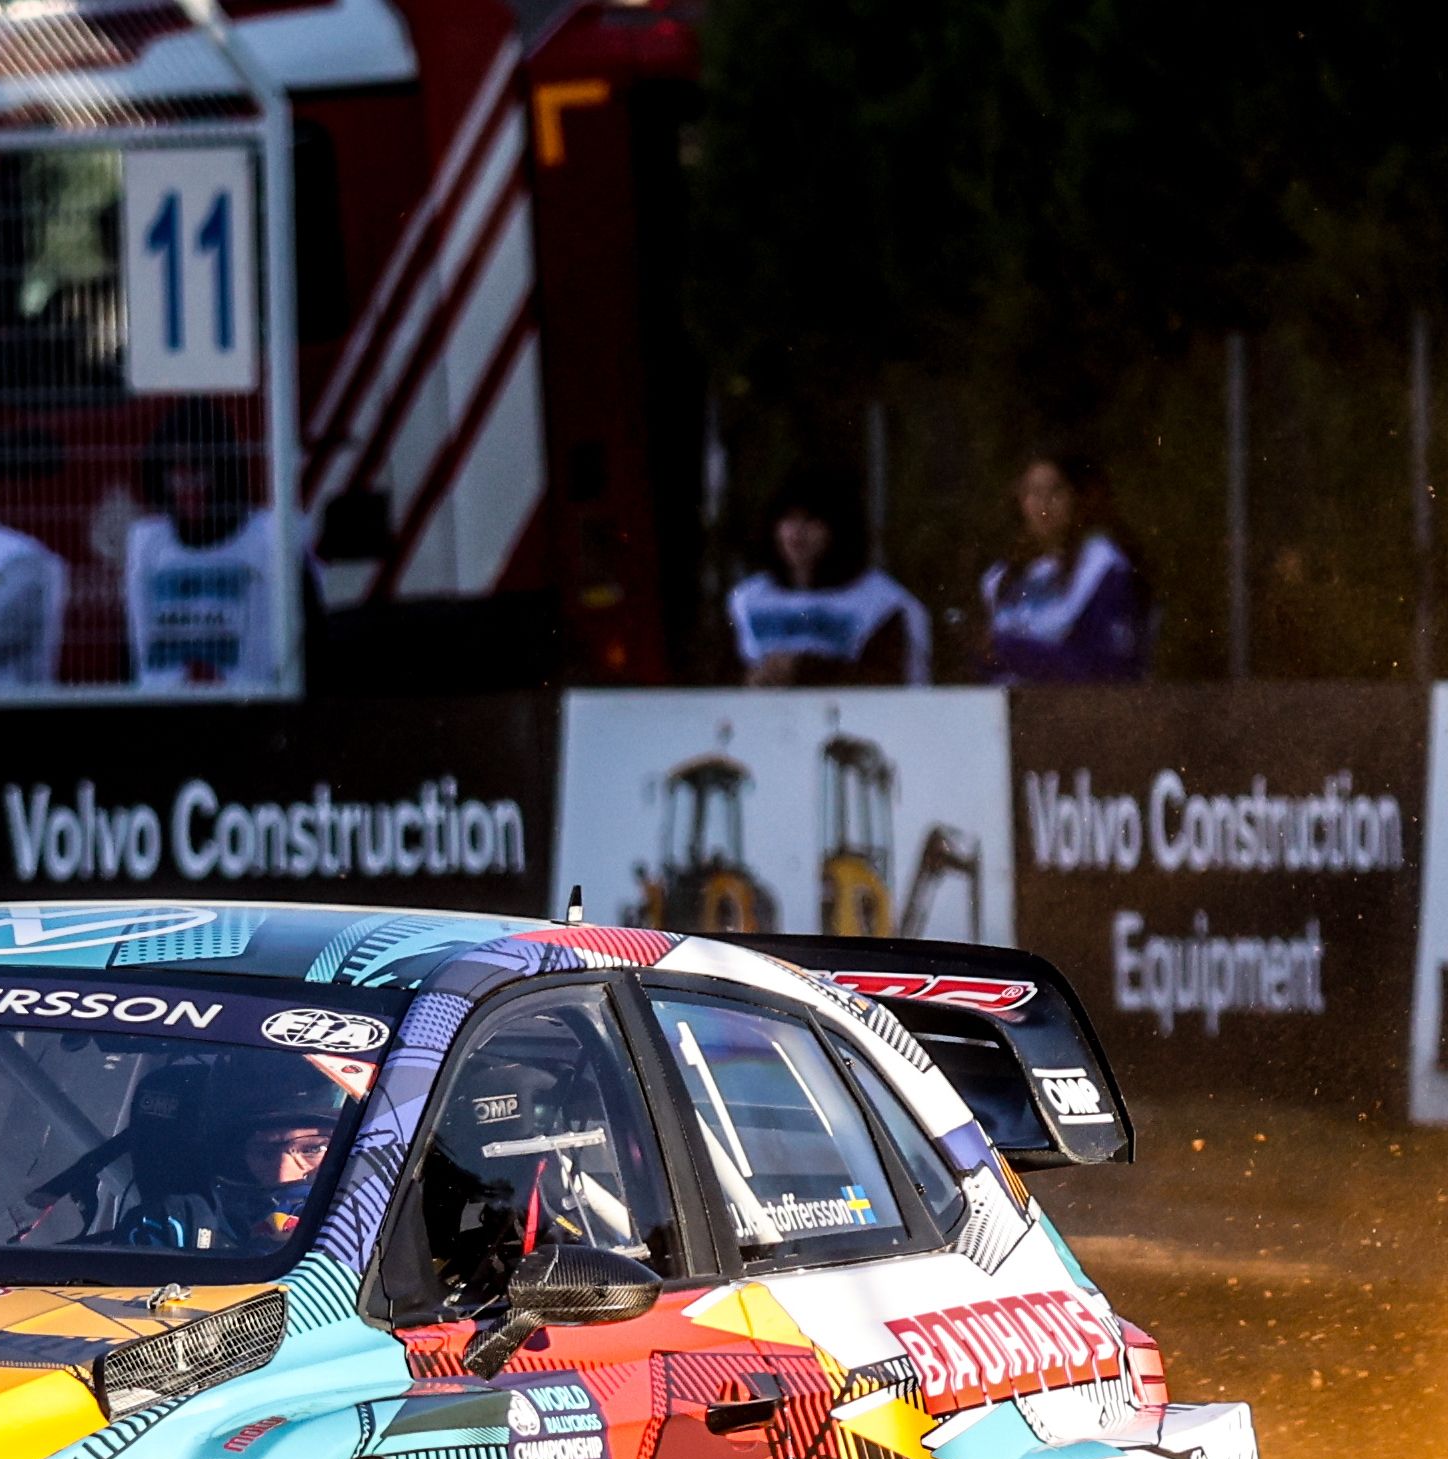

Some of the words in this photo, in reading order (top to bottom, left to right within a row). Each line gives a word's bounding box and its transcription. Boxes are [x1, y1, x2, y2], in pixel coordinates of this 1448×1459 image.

[145, 190, 233, 354] 11
[4, 780, 161, 881] Volvo
[172, 777, 526, 880] Construction
[1025, 769, 1142, 872] Volvo
[1153, 769, 1403, 872] Construction
[1114, 909, 1325, 1037] Equipment
[474, 1097, 519, 1121] OMP
[1042, 1078, 1101, 1115] OMP
[899, 1300, 1115, 1397] BAUHAUS
[527, 1385, 591, 1412] WORLD
[544, 1414, 603, 1434] RALLYCROSS
